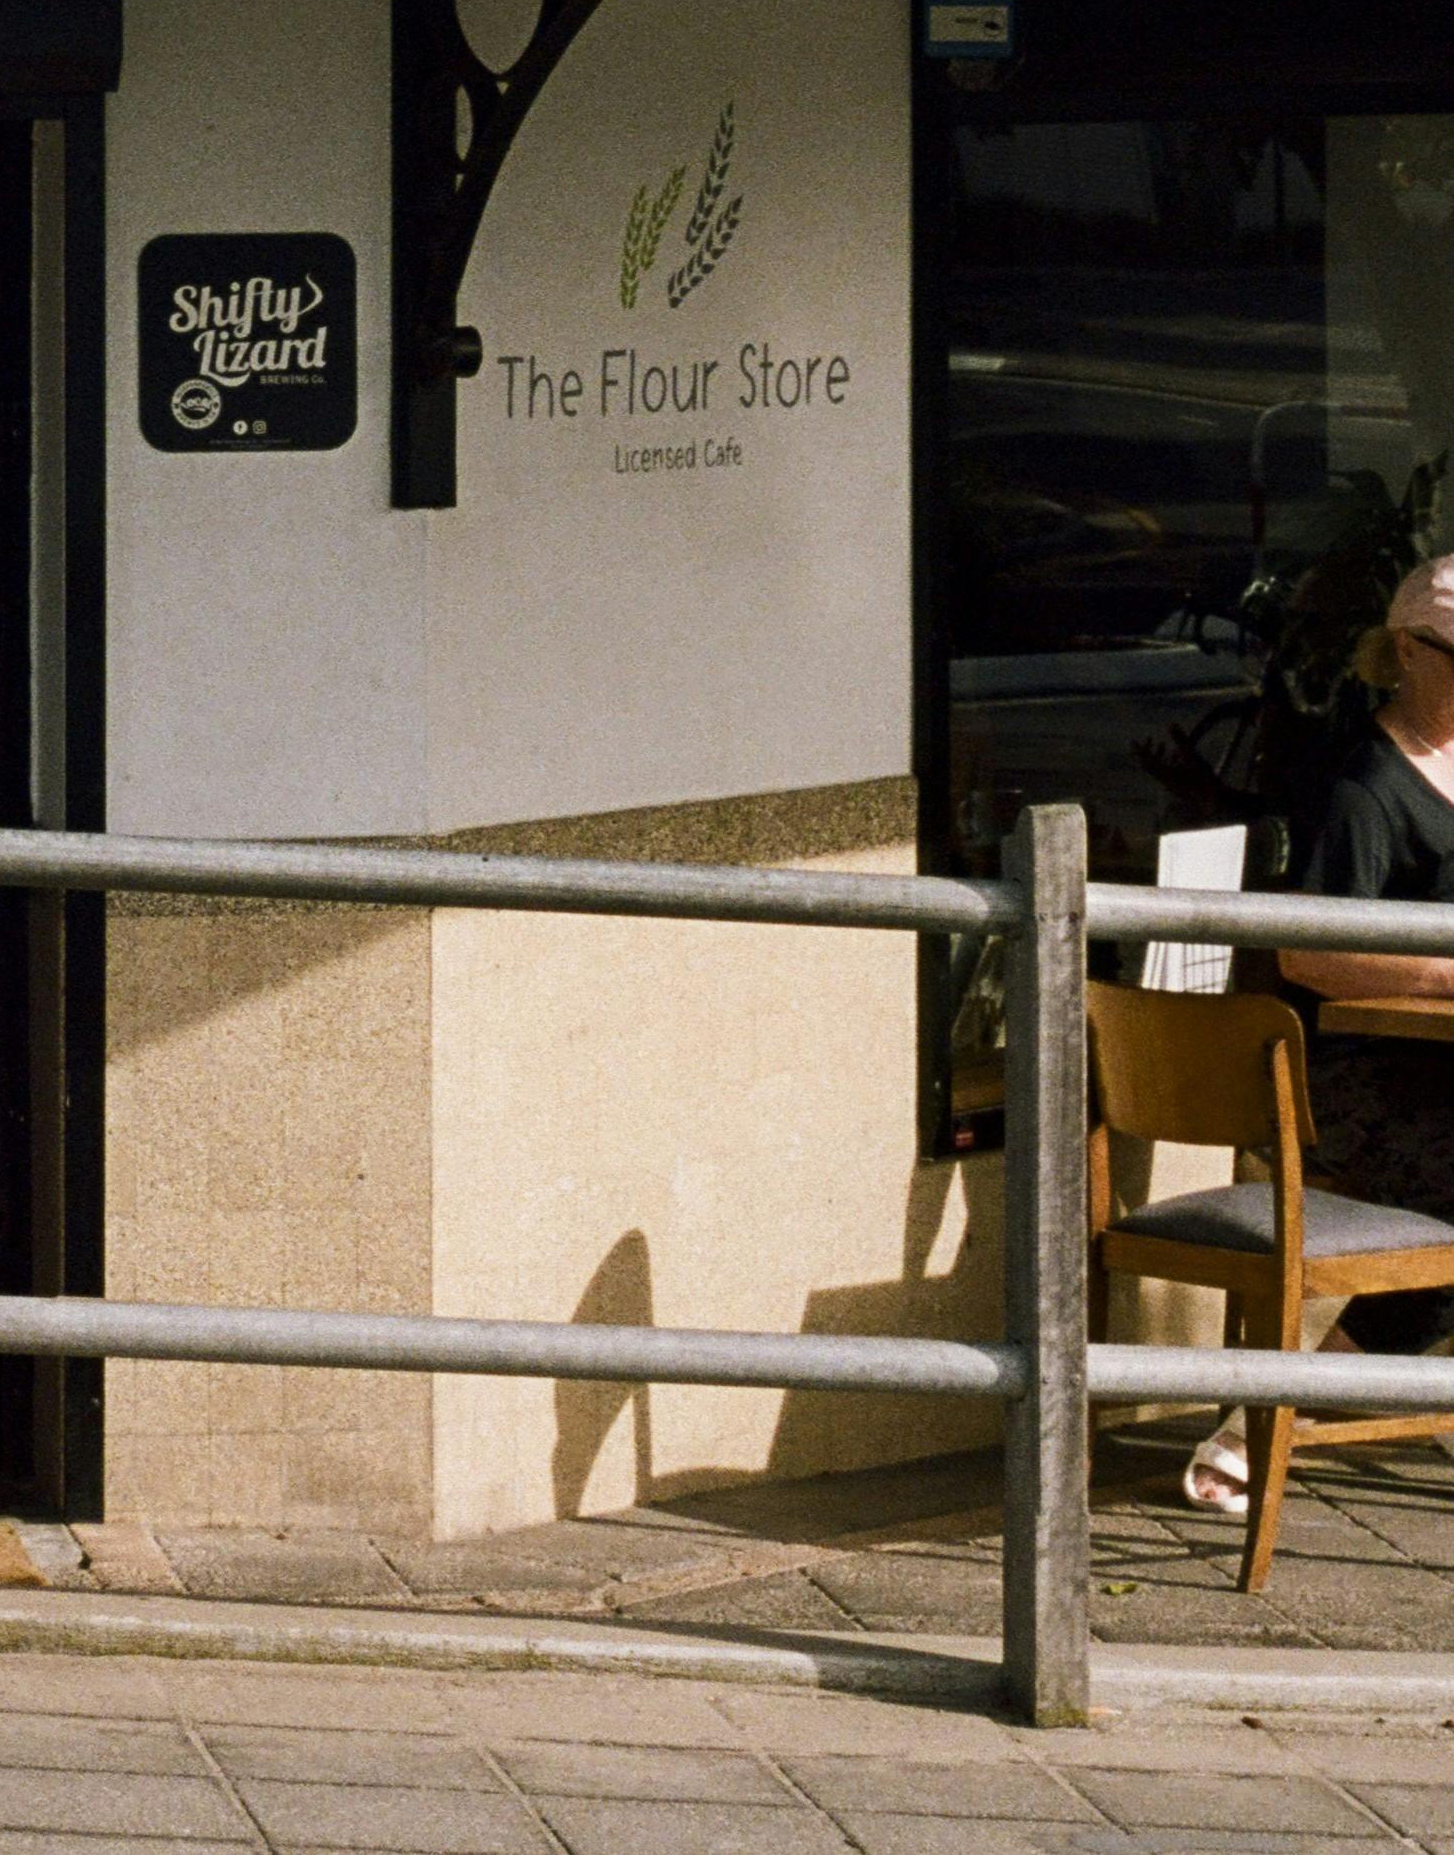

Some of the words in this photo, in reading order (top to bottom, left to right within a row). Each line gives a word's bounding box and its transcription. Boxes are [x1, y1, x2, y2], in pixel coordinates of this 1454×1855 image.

[168, 273, 324, 338] Shifty
[193, 325, 328, 387] Lizard
[496, 354, 584, 419] The
[600, 349, 719, 418] Flour
[738, 342, 851, 410] Store
[614, 440, 696, 474] Licensed
[703, 437, 744, 469] Cafe
